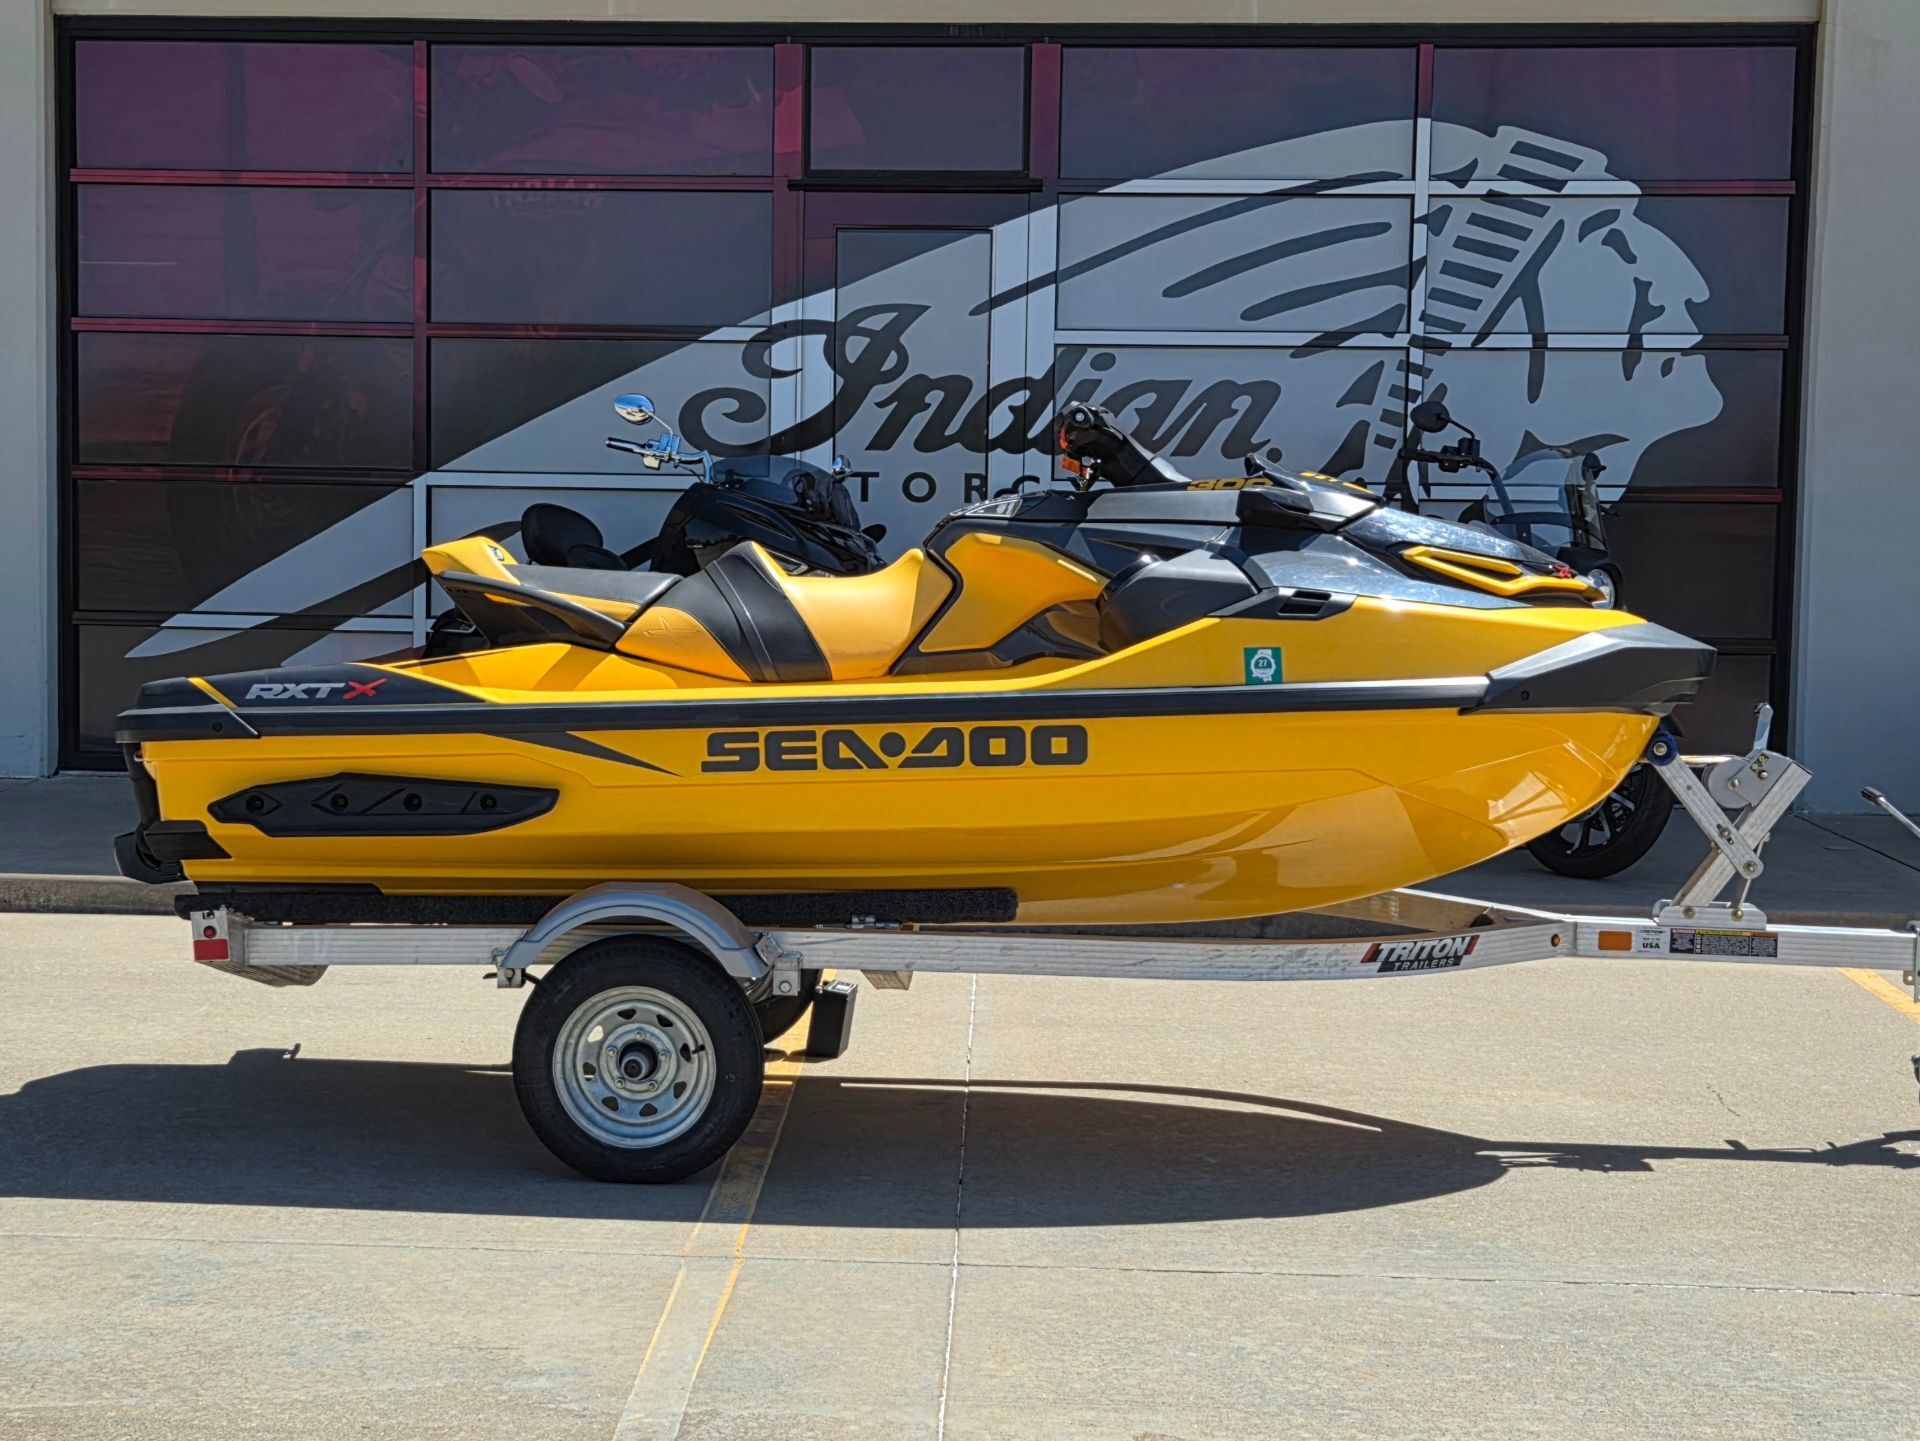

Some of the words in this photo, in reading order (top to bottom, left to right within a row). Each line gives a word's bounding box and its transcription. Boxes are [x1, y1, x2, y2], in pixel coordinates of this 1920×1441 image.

[1258, 659, 1268, 667] 27
[1376, 936, 1471, 962] TRITON
[1393, 957, 1455, 971] TRAILERS
